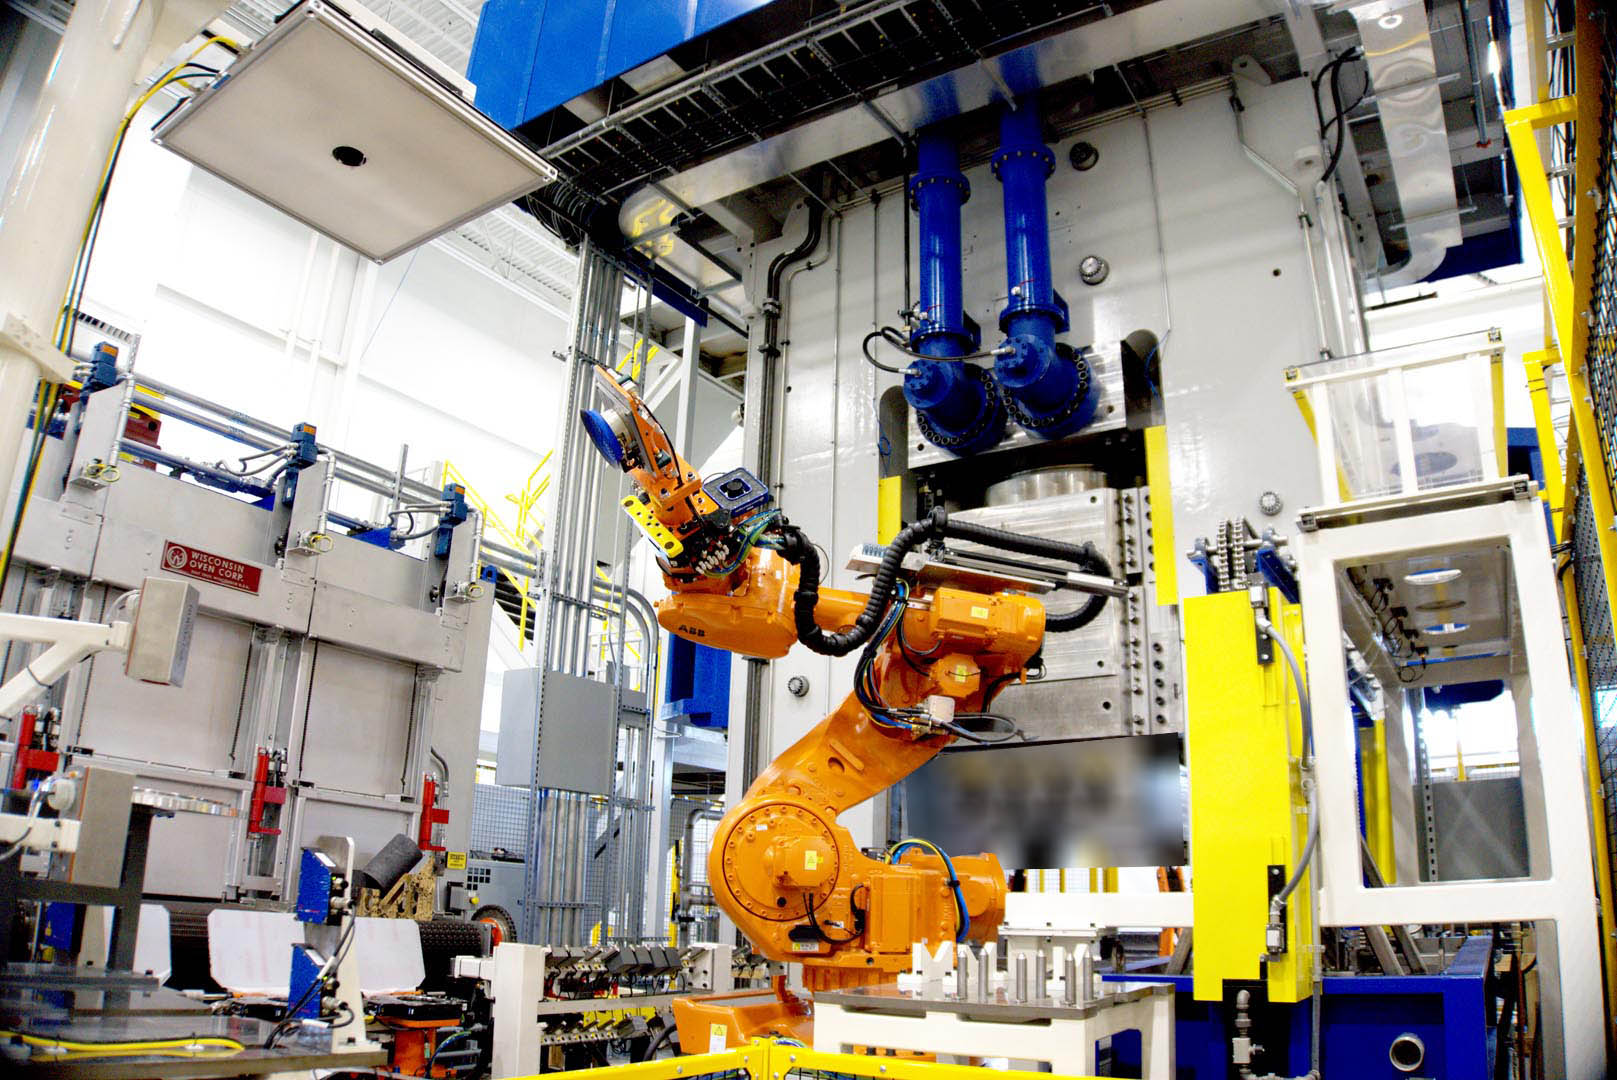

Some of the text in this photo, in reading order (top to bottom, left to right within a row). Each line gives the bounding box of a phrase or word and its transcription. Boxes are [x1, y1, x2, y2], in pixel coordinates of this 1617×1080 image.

[189, 560, 215, 573] OVEN
[218, 568, 244, 582] CORP.
[191, 551, 245, 573] WISCONSIN
[678, 624, 705, 637] ABB
